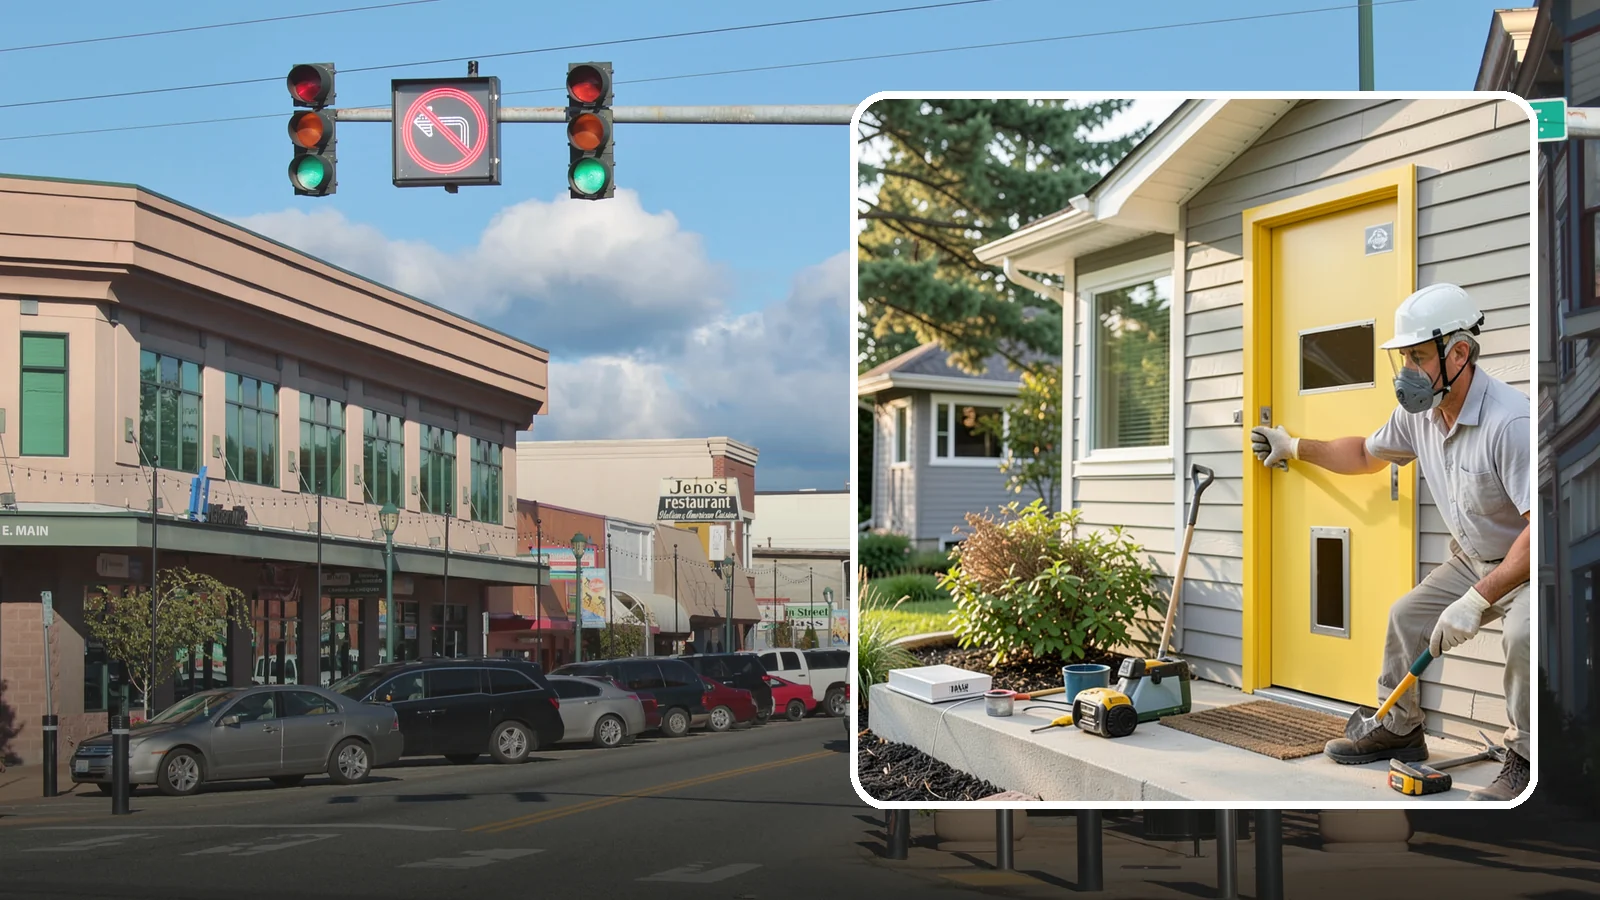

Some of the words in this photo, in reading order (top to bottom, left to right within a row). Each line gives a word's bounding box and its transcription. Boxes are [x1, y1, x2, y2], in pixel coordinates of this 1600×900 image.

[669, 479, 728, 495] Jeno's
[665, 496, 731, 509] restaurant
[658, 510, 681, 519] Italian
[685, 510, 714, 519] American
[714, 510, 738, 519] Cuisine
[2, 525, 13, 536] E.
[15, 525, 49, 536] MAIN
[797, 607, 828, 617] Street
[791, 619, 823, 627] lass
